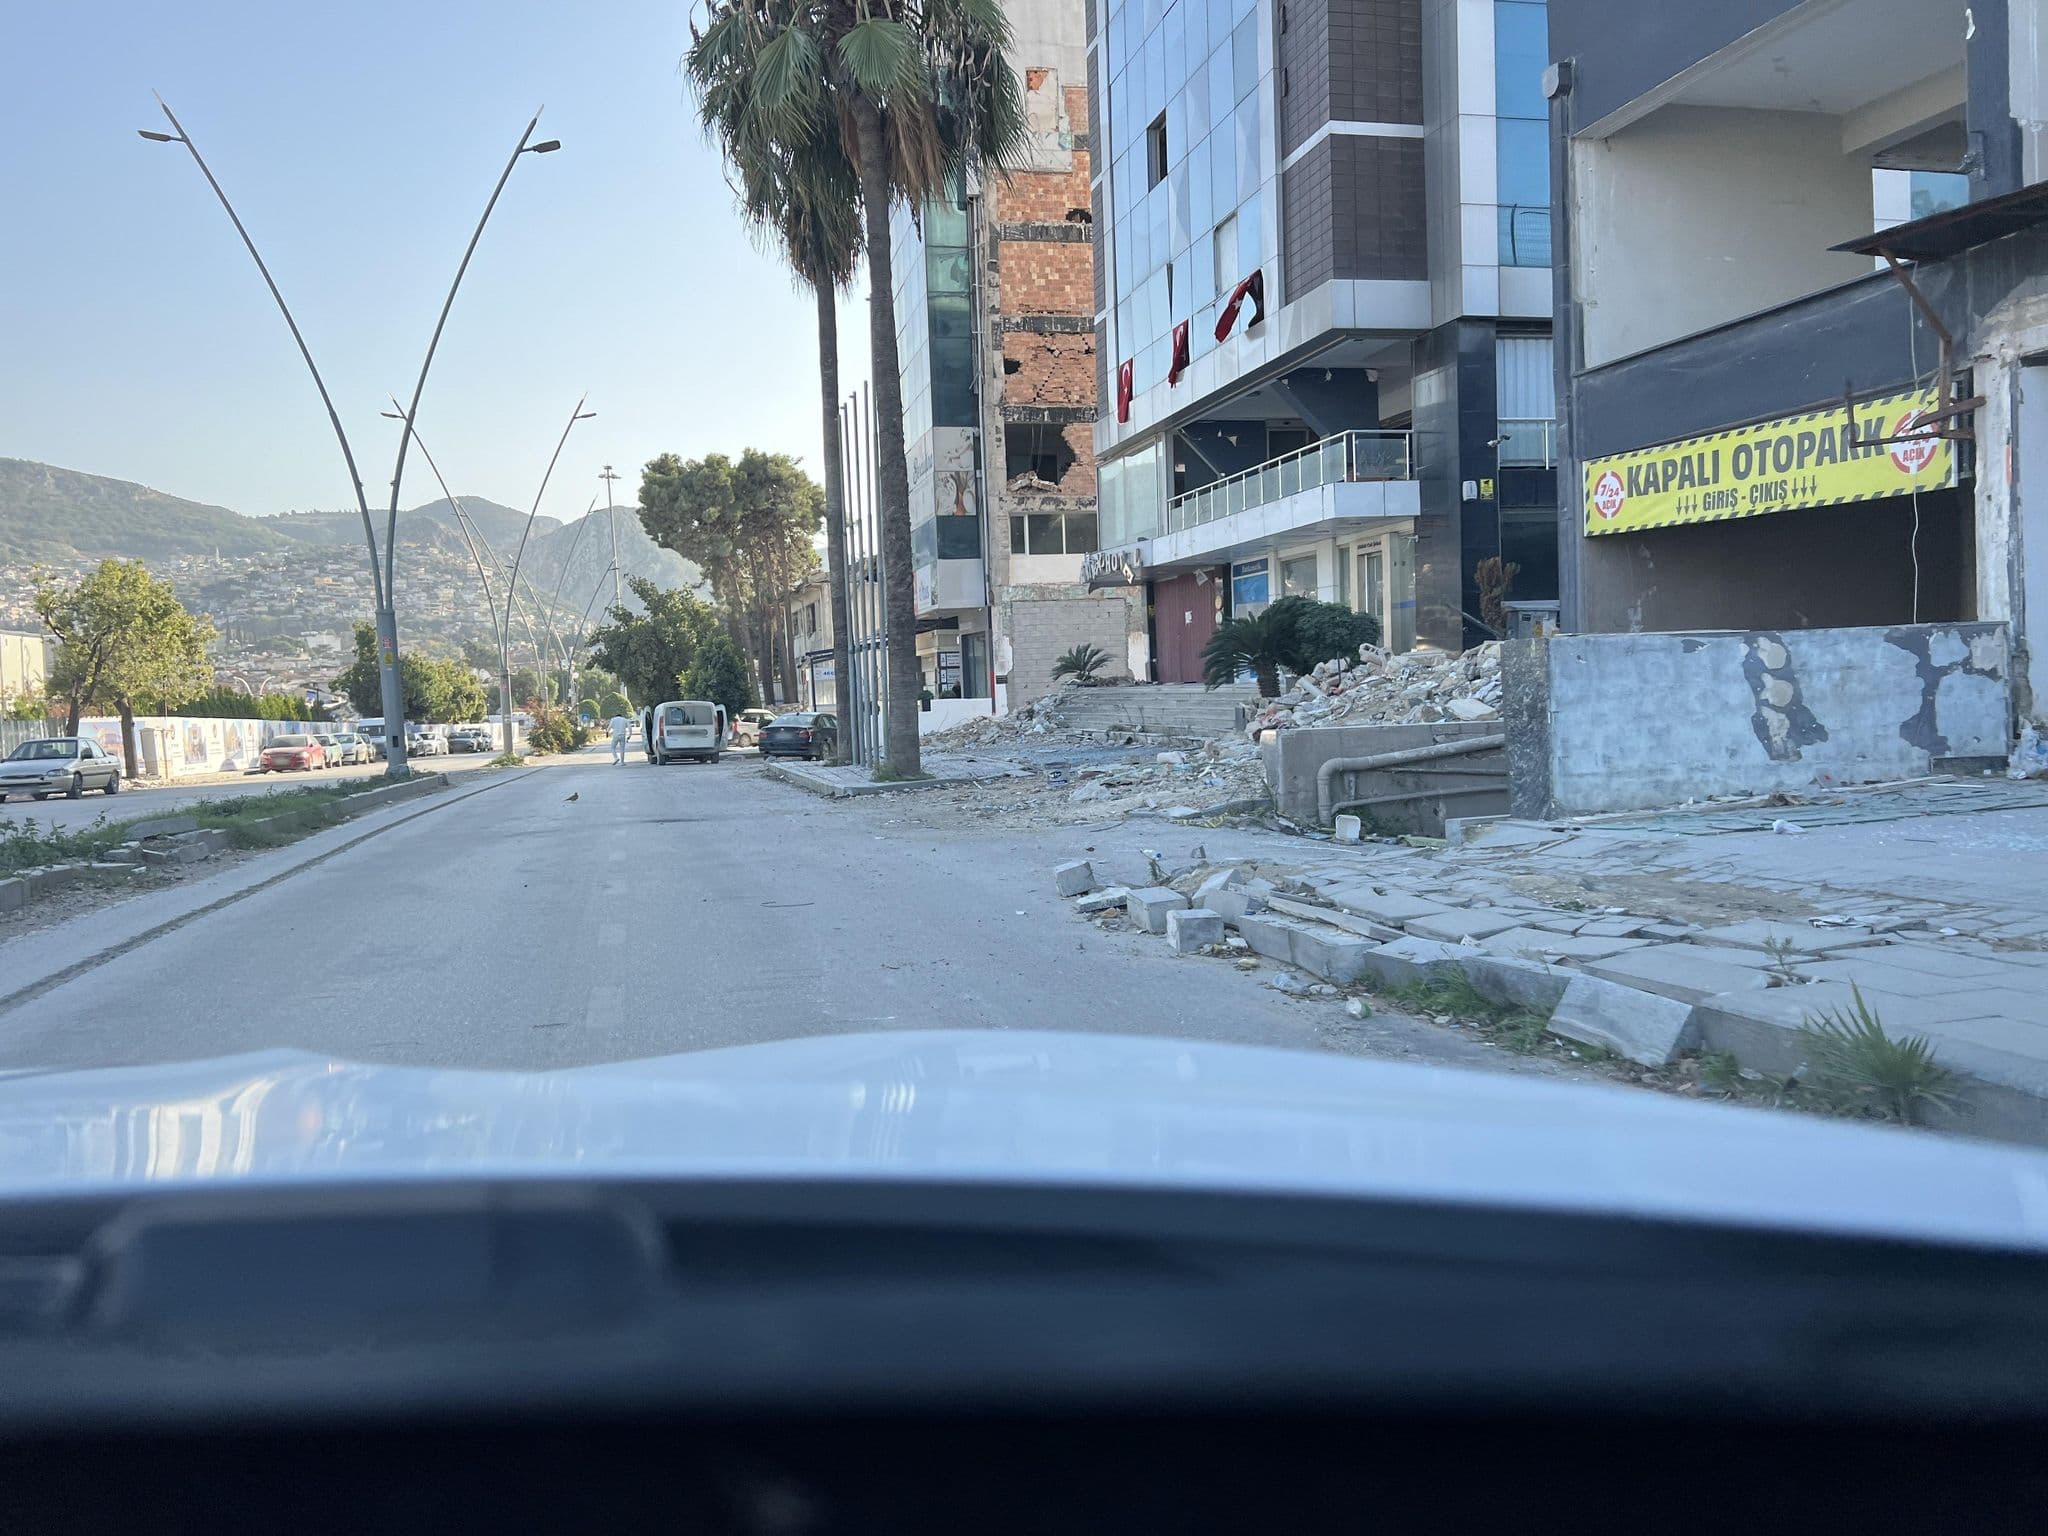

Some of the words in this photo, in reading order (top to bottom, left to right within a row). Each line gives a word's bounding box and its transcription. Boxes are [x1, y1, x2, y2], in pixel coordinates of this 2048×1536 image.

[1626, 449, 1720, 498] KAPALI
[1732, 415, 1886, 481] OTOPARK
[1600, 483, 1620, 498] 7/24
[1749, 479, 1788, 508] ÇIKIŞ
